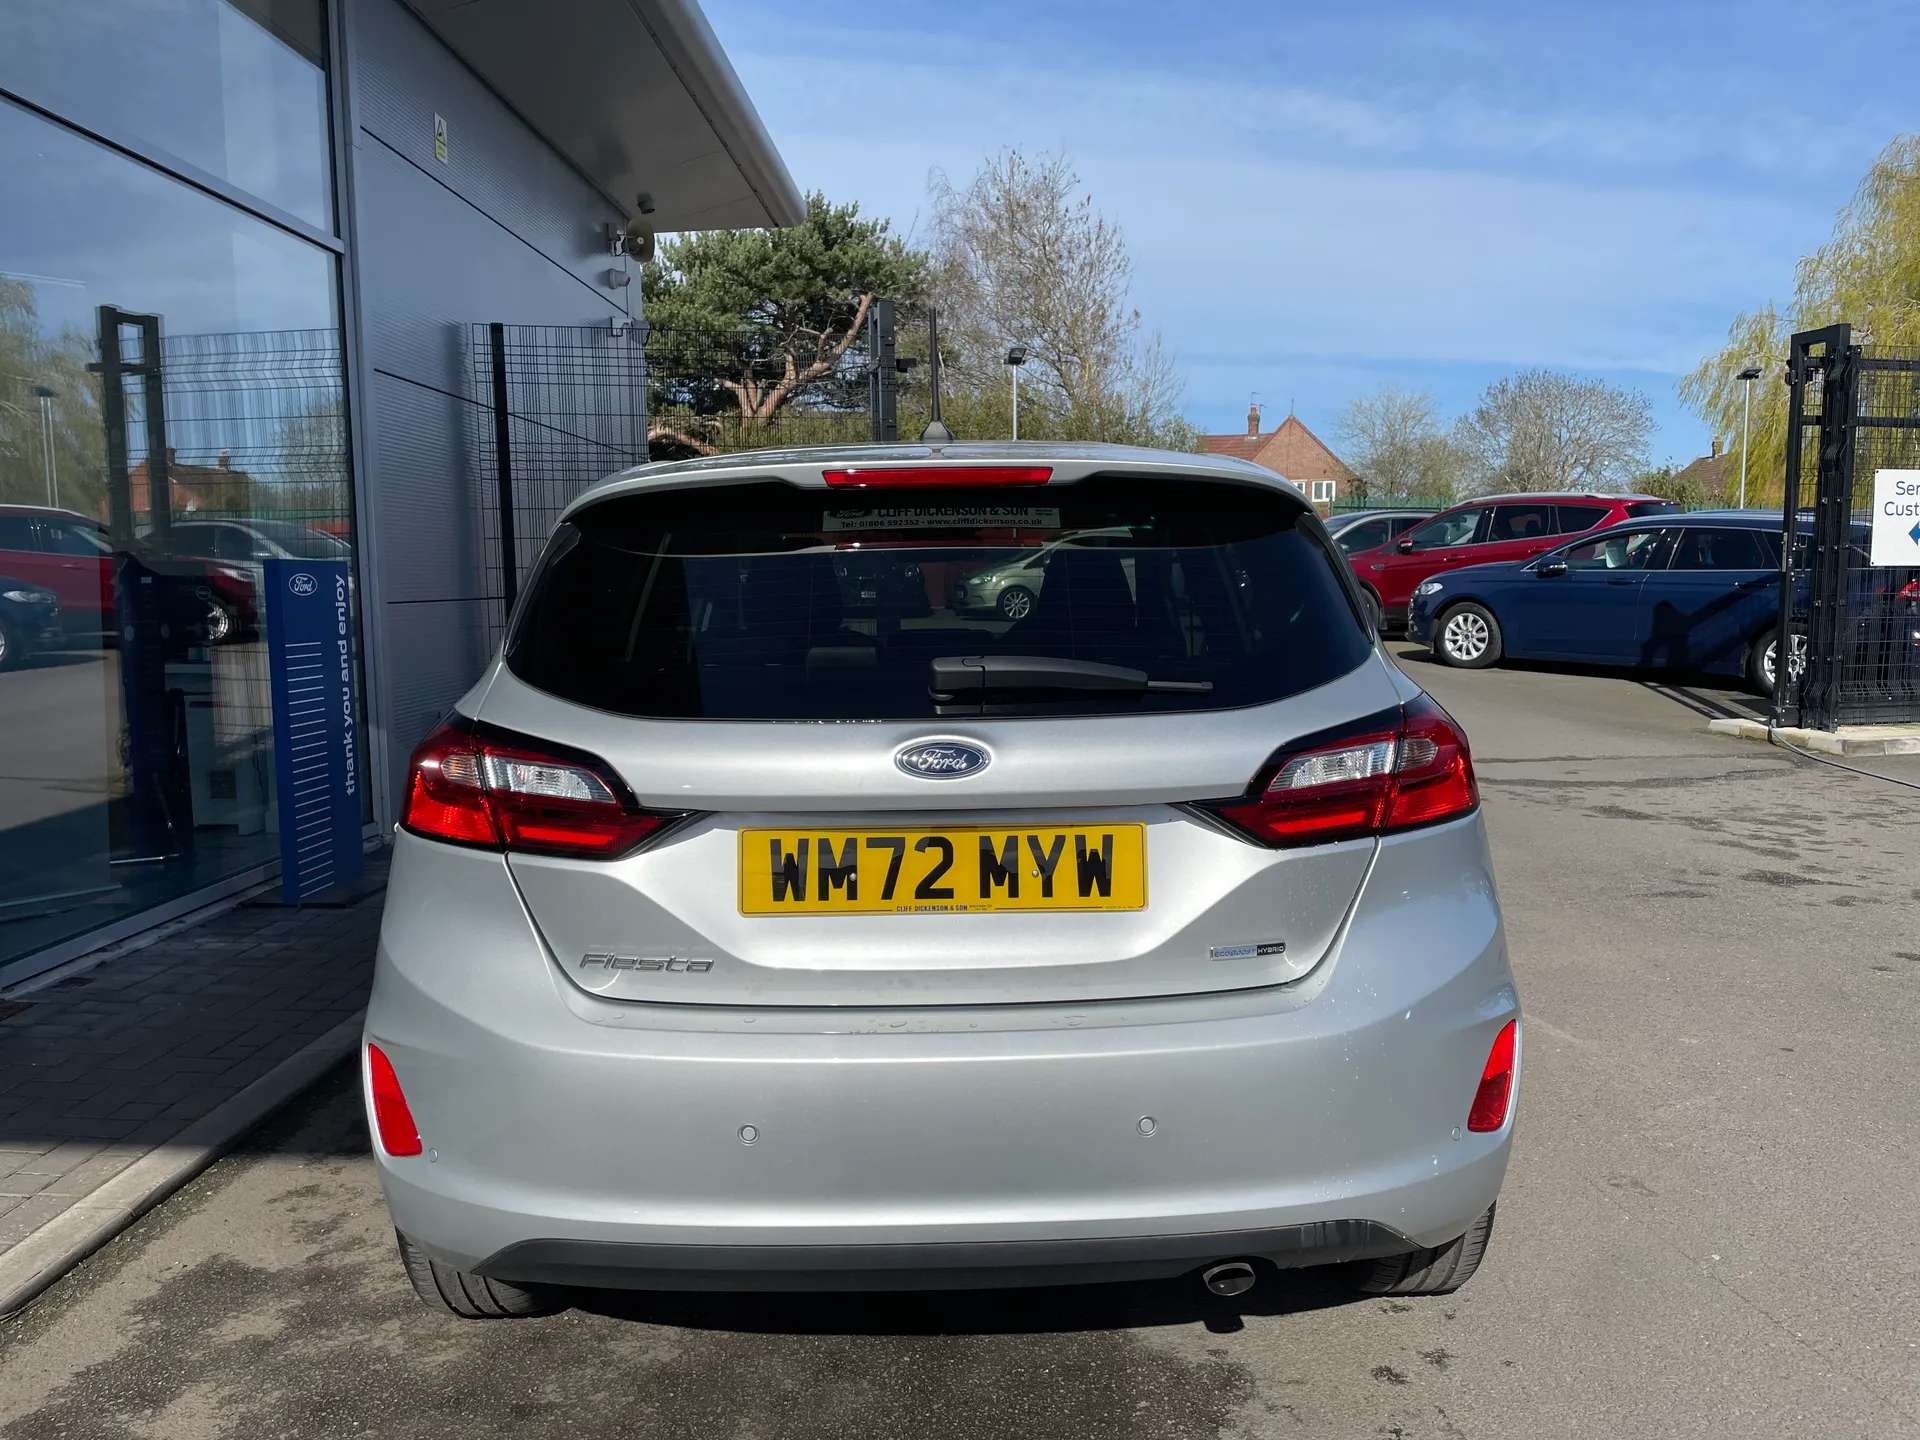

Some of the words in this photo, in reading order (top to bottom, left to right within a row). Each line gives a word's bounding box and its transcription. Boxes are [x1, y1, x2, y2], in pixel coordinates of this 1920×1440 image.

[1002, 505, 1028, 516] SON
[294, 576, 313, 593] Ford
[335, 574, 347, 635] enjoy
[337, 640, 349, 682] and
[342, 687, 353, 728] you
[343, 730, 355, 796] thank
[917, 749, 968, 770] Ford
[769, 835, 954, 902] WM72
[979, 834, 1113, 898] MYW
[579, 953, 715, 973] Fiesta
[1257, 944, 1284, 954] HYBRID
